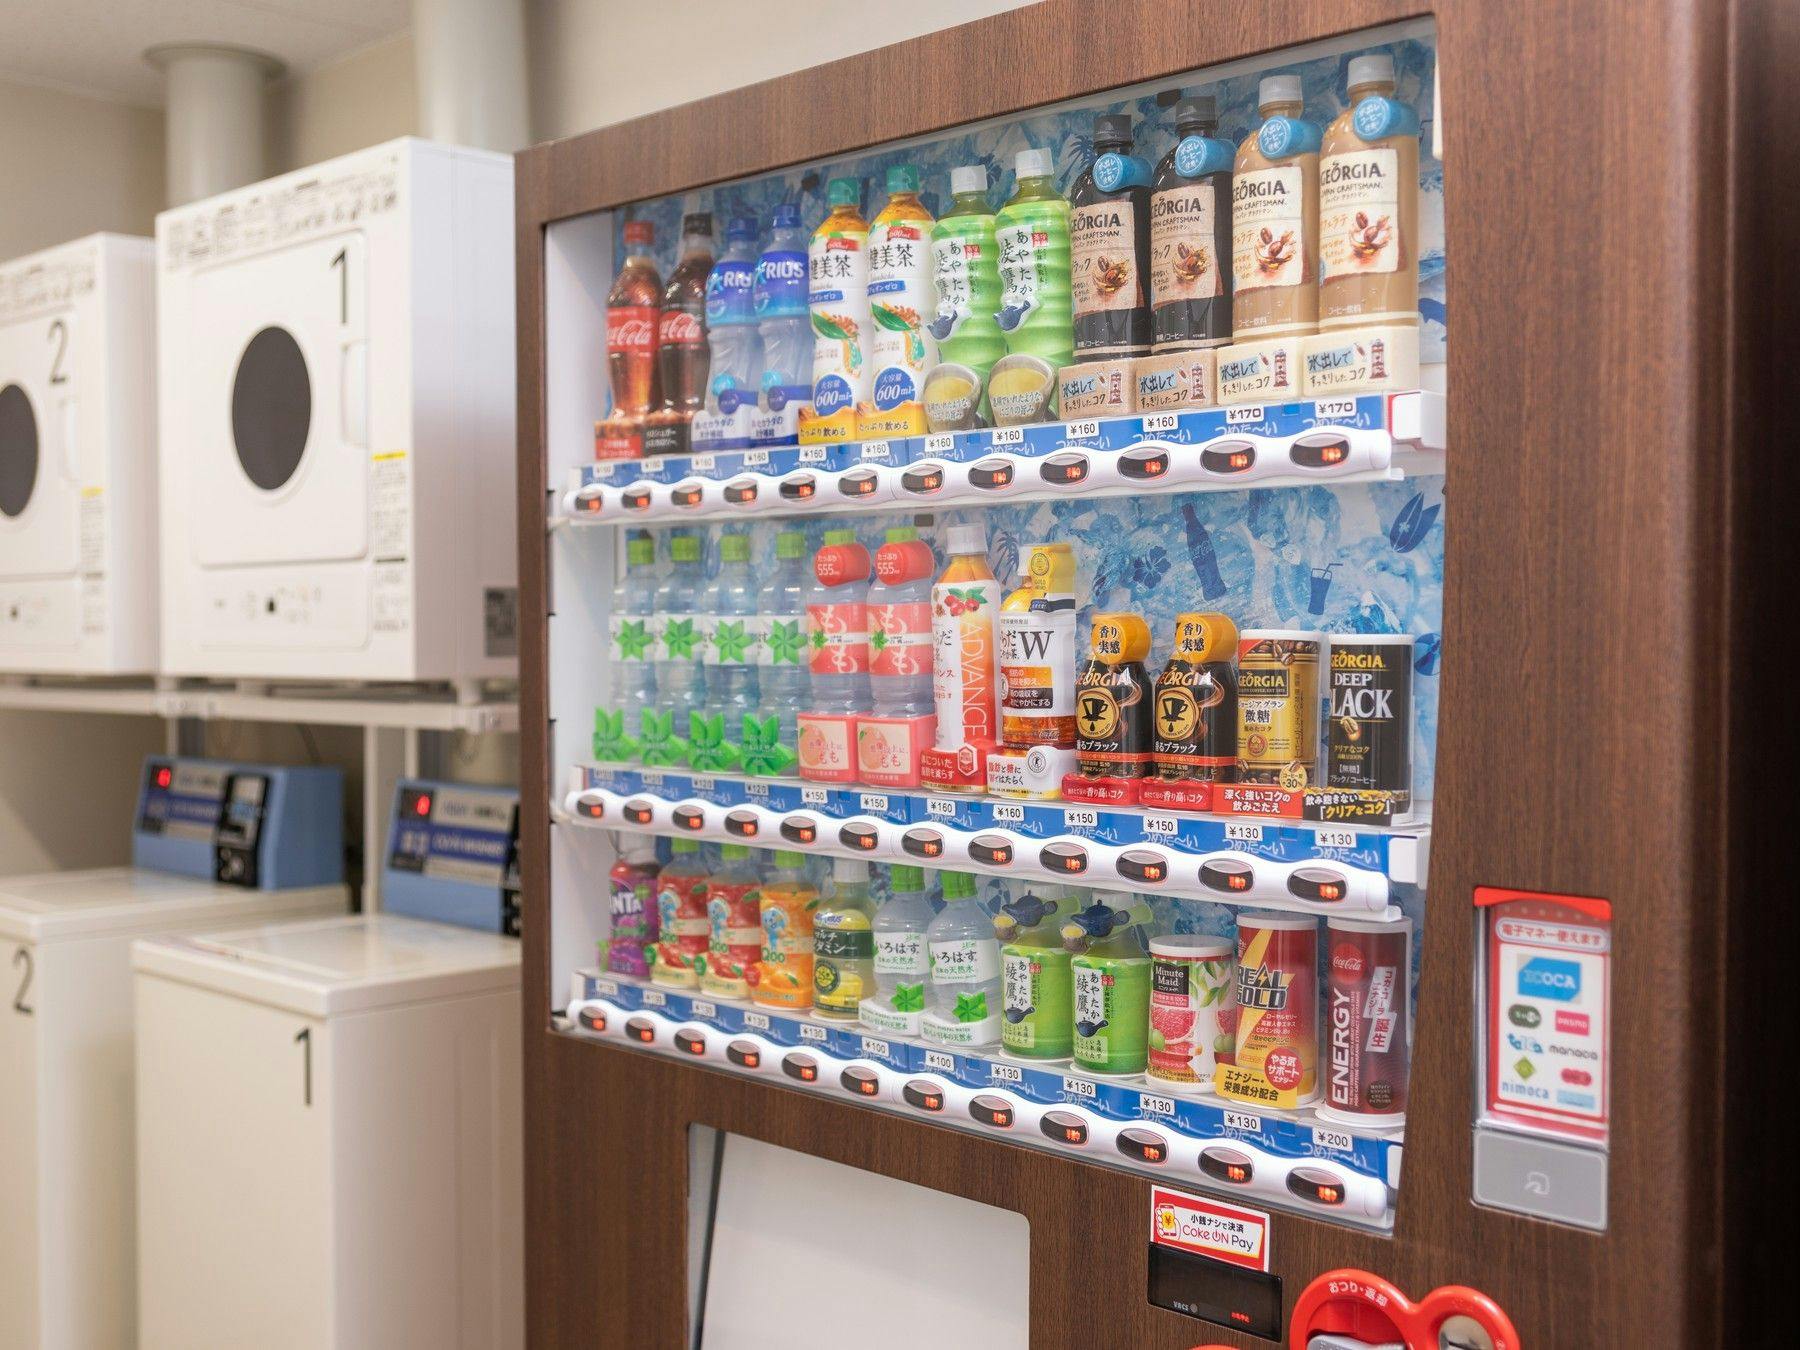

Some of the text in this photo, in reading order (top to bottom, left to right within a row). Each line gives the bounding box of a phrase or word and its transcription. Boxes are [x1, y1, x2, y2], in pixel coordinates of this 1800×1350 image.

[1337, 183, 1381, 194] CRAFTSMAN
[1152, 196, 1201, 218] EORGIA
[1244, 199, 1285, 211] CRAFTSMAN
[1072, 211, 1121, 233] EORGIA
[1163, 216, 1200, 226] CRAFTSMAN
[1083, 230, 1119, 240] CRAFTSMAN
[1016, 230, 1032, 296] あやたか
[950, 241, 964, 305] あやたか
[329, 246, 350, 325] 1
[47, 318, 70, 385] 2
[1310, 368, 1366, 387] すっきりしたコク
[1221, 375, 1270, 396] すっきりしたコク
[1064, 393, 1105, 413] すっきりしたコク
[1141, 389, 1188, 409] すっきりしたコク
[1229, 409, 1262, 420] ¥170
[1318, 402, 1354, 413] ¥170
[1070, 423, 1096, 435] ¥160
[1148, 416, 1174, 428] ¥160
[996, 430, 1020, 441] ¥160
[865, 444, 887, 454] ¥160
[930, 438, 951, 448] ¥160
[804, 450, 823, 459] ¥160
[1100, 625, 1118, 639] 香り
[1184, 622, 1203, 636] 香り
[1018, 630, 1054, 660] W
[1099, 640, 1120, 655] 実感
[1182, 638, 1205, 653] 実感
[960, 619, 987, 736] ADVANCE
[1335, 673, 1373, 687] DEEP
[1331, 689, 1393, 719] LACK
[1245, 709, 1271, 723] 微糖
[805, 792, 824, 801] ¥150
[1224, 789, 1291, 803] 深く、強いコクの
[1305, 793, 1358, 806] 飲み飽きない
[864, 799, 885, 808] ¥150
[931, 803, 953, 813] ¥160
[1233, 801, 1281, 814] 飲みごたえ
[998, 808, 1021, 818] ¥160
[1068, 813, 1094, 825] ¥150
[1148, 819, 1174, 832] ¥150
[1229, 826, 1259, 839] ¥130
[1321, 833, 1353, 846] ¥130
[1502, 923, 1601, 945] 電子マネー使えます
[762, 948, 786, 964] Qoo
[1156, 966, 1184, 978] Minute
[13, 948, 35, 1015] 2
[1006, 963, 1017, 1002] 綾鷹
[1019, 960, 1027, 1006] あやたか
[1158, 976, 1180, 987] Maid
[1077, 974, 1089, 1014] 綾鷹
[1090, 972, 1099, 1020] あやたか
[803, 1027, 824, 1039] ¥130
[1371, 1018, 1390, 1048] 誕生
[865, 1041, 887, 1054] ¥100
[1332, 987, 1351, 1105] ENERGY
[1549, 1045, 1598, 1060] manaca
[295, 1027, 313, 1108] 1
[929, 1055, 952, 1068] ¥100
[1271, 1054, 1297, 1067] やる気
[994, 1067, 1019, 1080] ¥130
[1268, 1065, 1300, 1078] サポート
[1273, 1076, 1294, 1084] エナジー
[1066, 1080, 1094, 1095] ¥130
[1224, 1082, 1279, 1102] 栄養成分配合
[1502, 1082, 1550, 1099] nimoca
[1142, 1097, 1171, 1113] ¥130
[1227, 1114, 1258, 1130] ¥130
[1317, 1132, 1348, 1147] ¥200
[1191, 1214, 1244, 1233] 小銭ナシで決済
[1182, 1225, 1210, 1241] Coke
[1232, 1235, 1254, 1252] Pay
